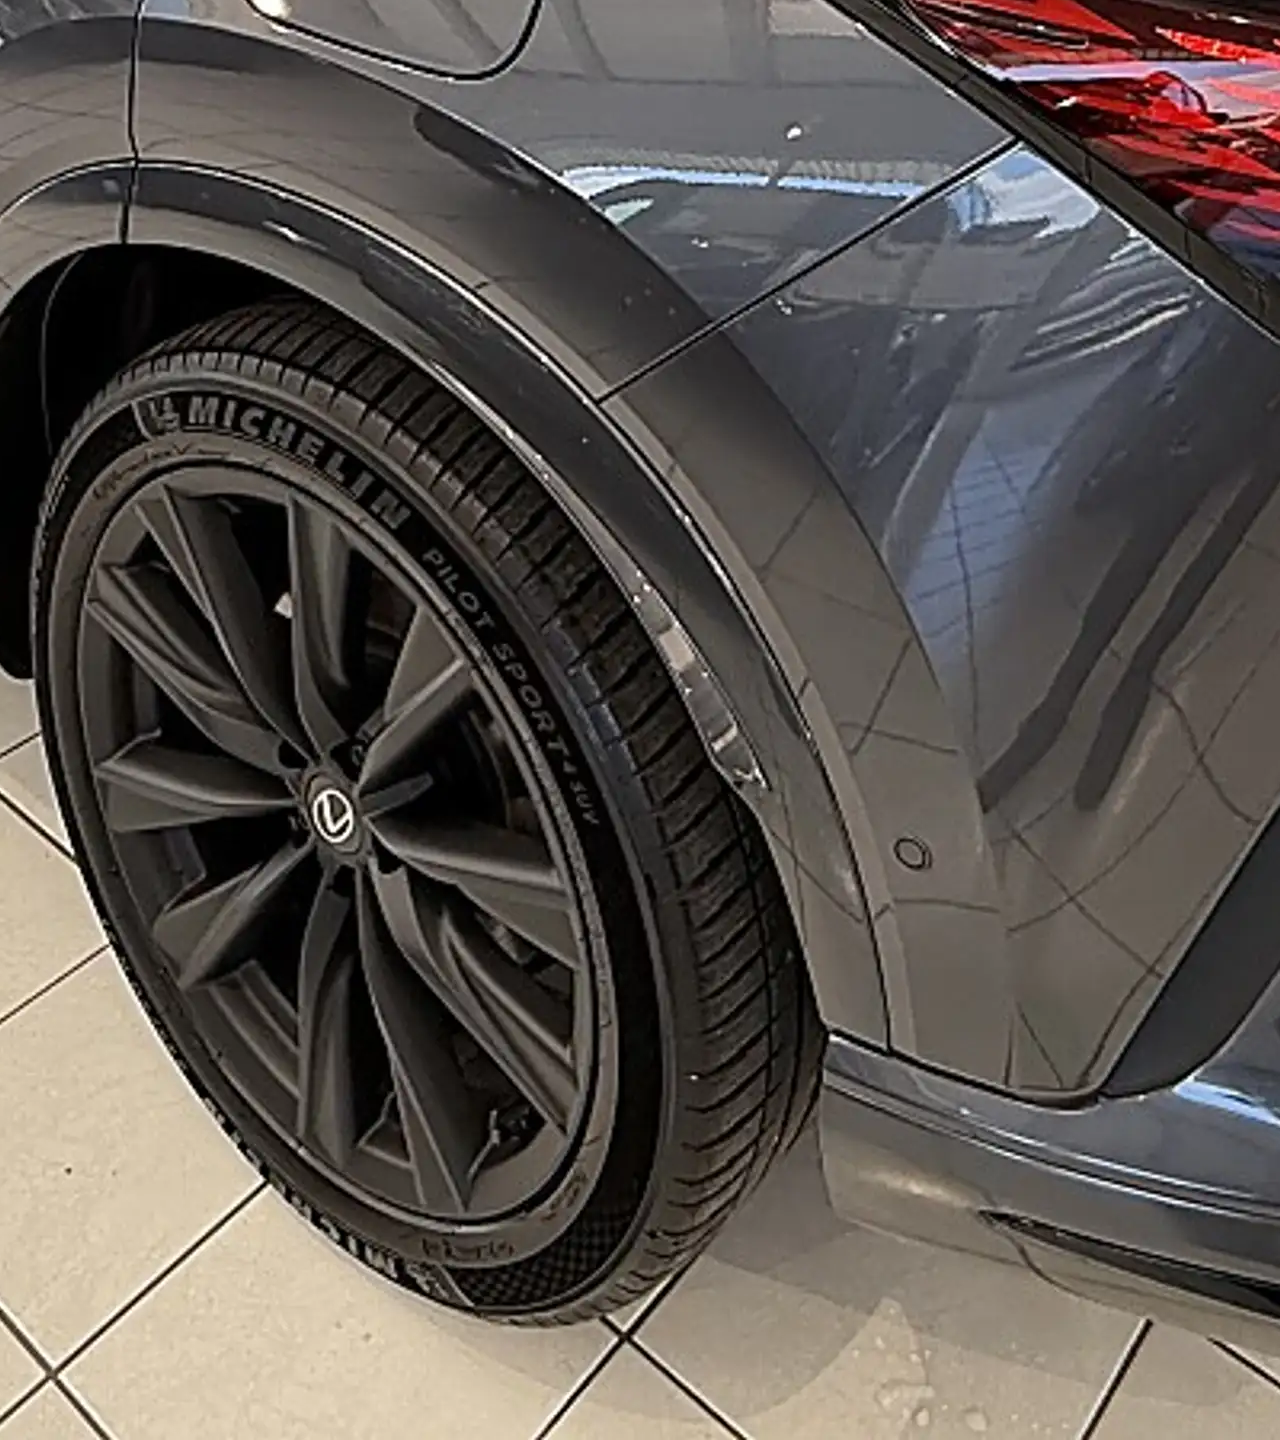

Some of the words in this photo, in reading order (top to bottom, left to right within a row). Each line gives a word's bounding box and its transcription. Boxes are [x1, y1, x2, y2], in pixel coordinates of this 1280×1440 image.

[188, 396, 412, 530] MICHELIN
[422, 546, 496, 629] PILOT
[492, 643, 570, 757] SPORT
[569, 779, 600, 825] SUV
